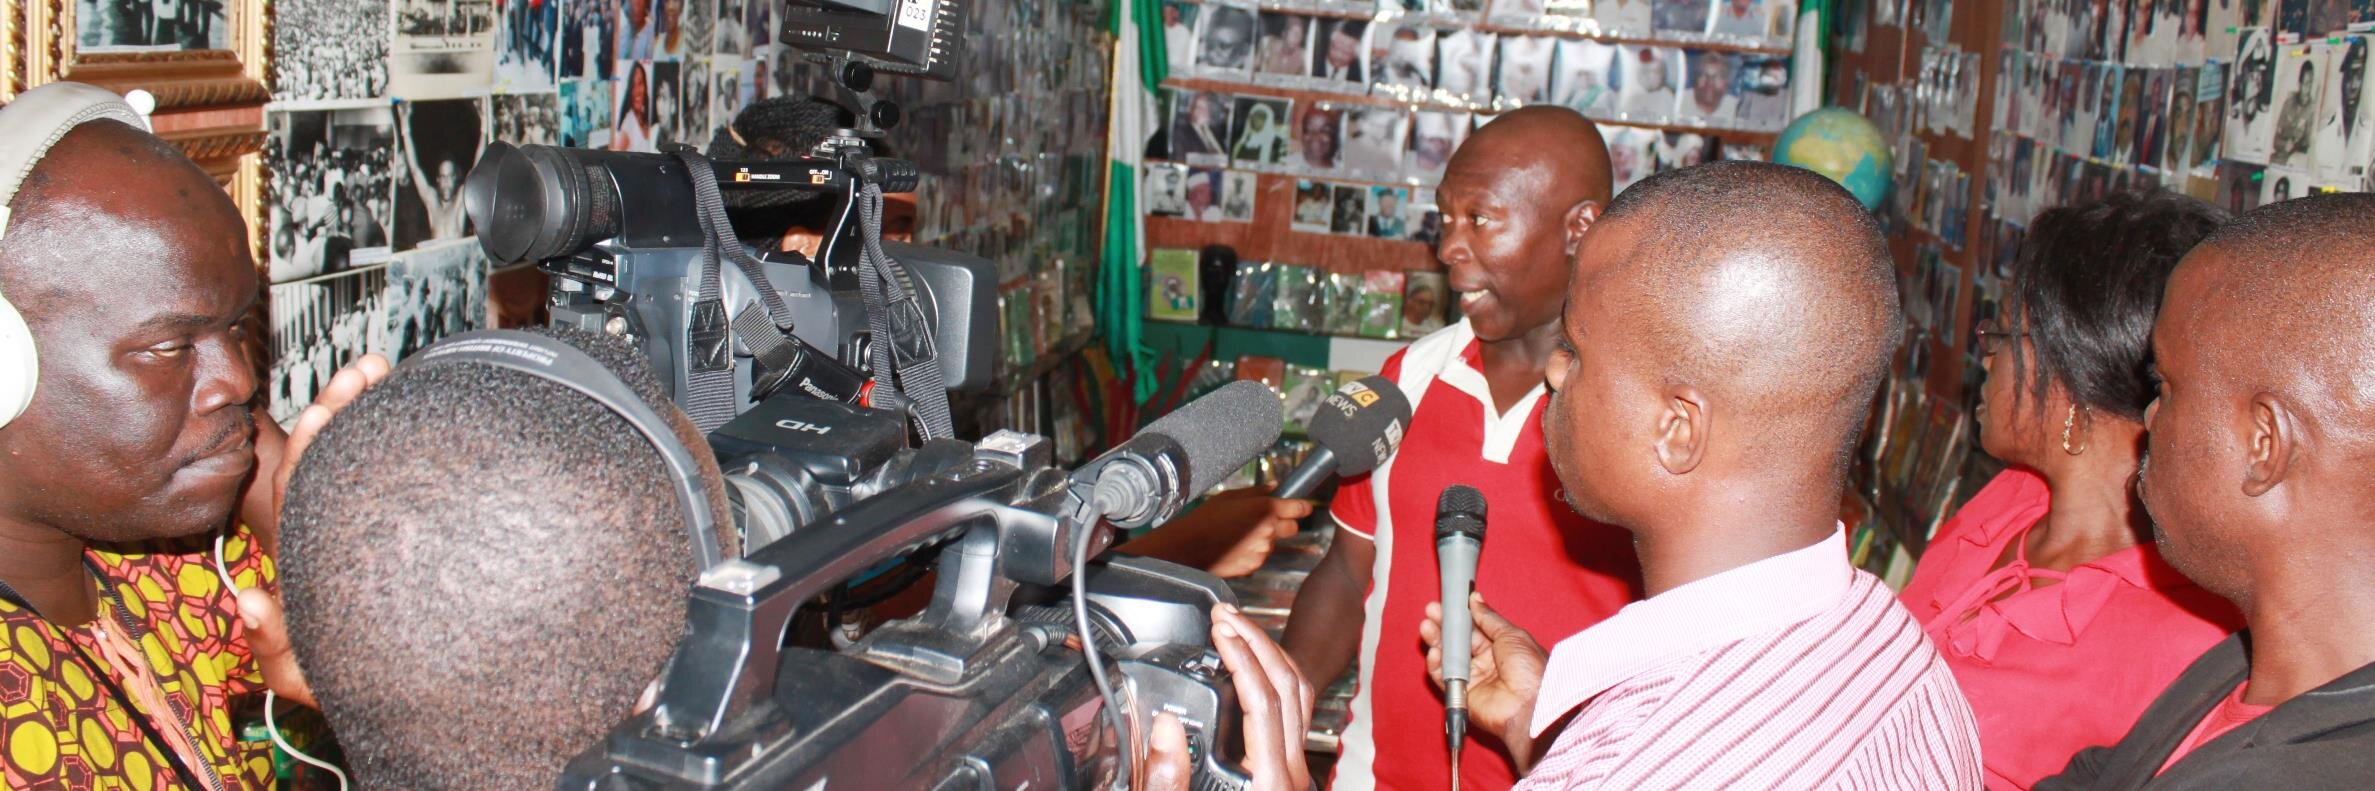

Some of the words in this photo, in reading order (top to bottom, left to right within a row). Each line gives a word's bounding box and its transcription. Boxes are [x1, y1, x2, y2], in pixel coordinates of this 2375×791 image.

[906, 6, 926, 21] 023
[1327, 394, 1358, 417] NEWS
[775, 419, 831, 435] HD
